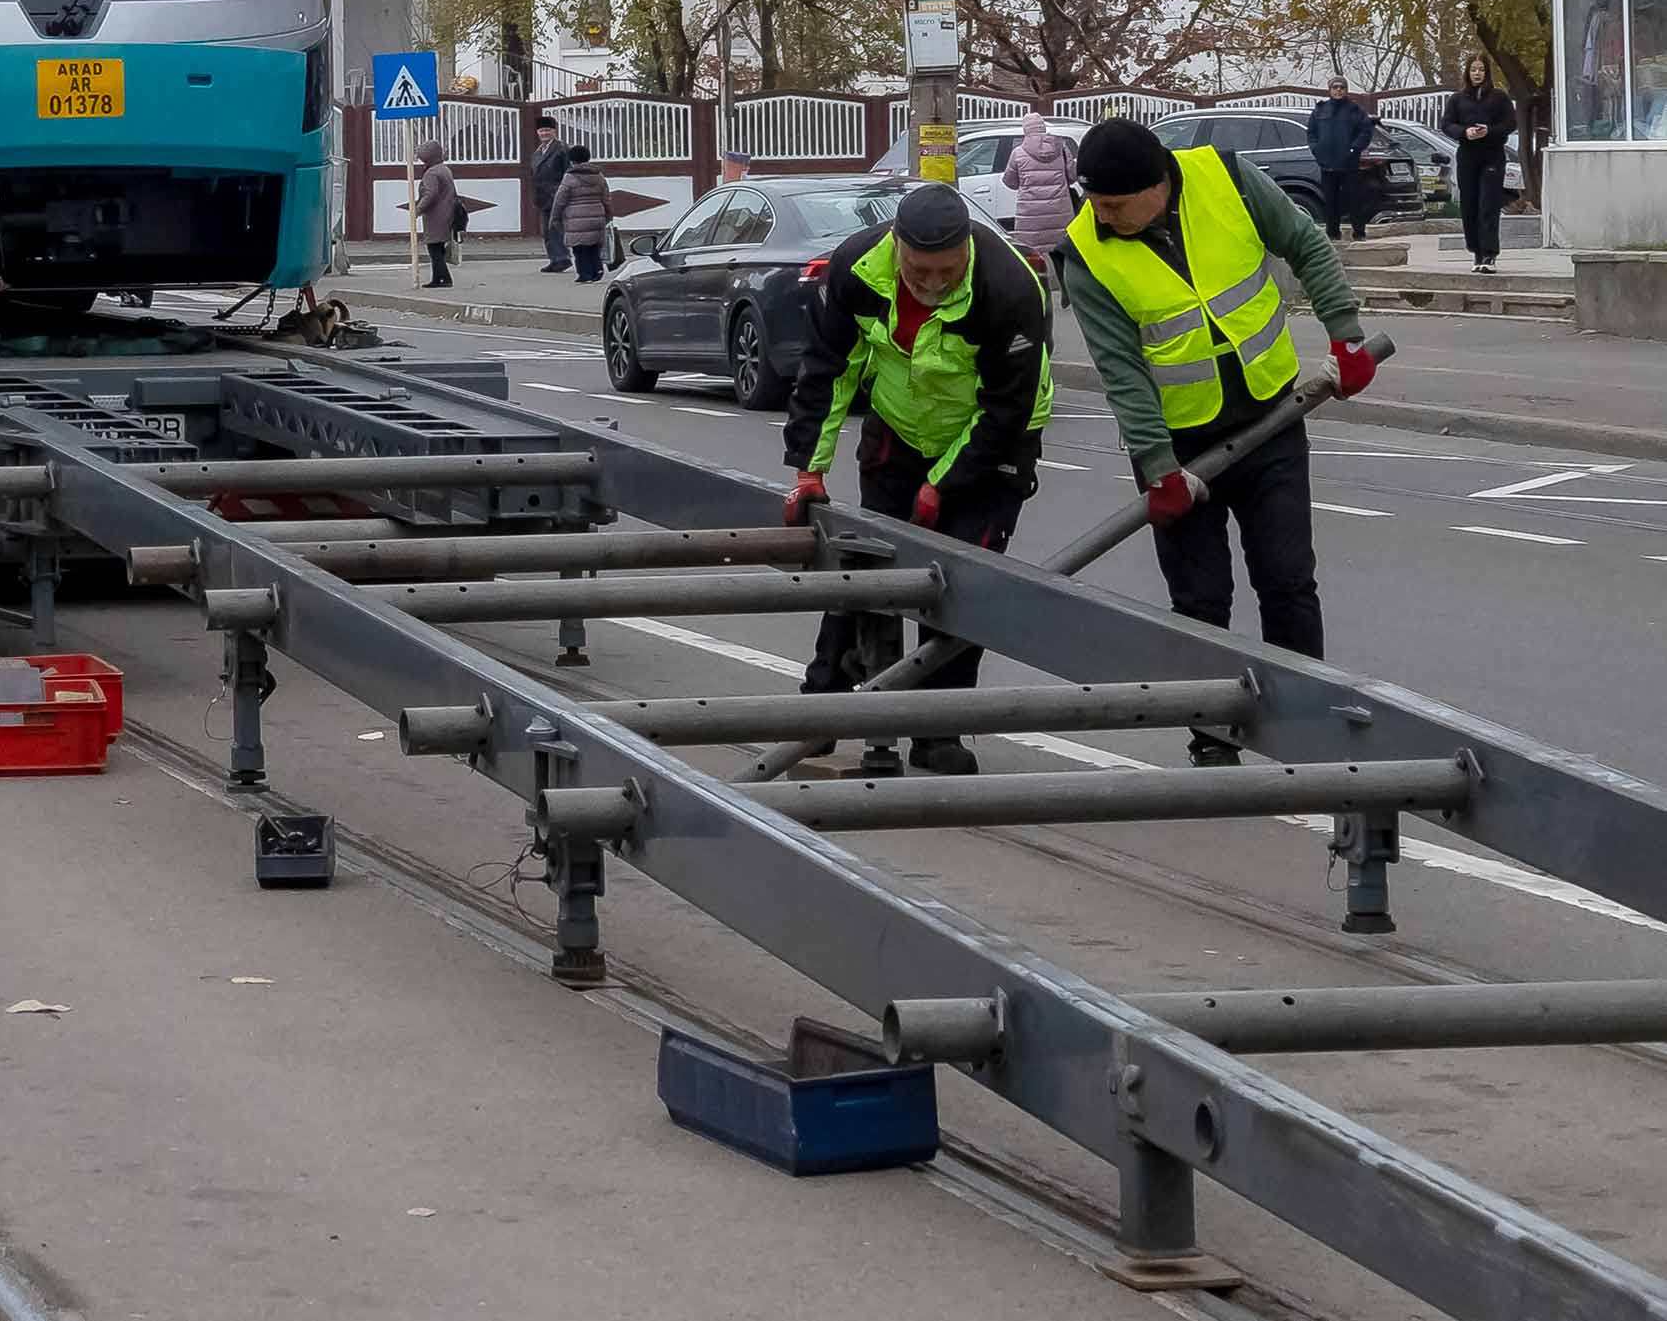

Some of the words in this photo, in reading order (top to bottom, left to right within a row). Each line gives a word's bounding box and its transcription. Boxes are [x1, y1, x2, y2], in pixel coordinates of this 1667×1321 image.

[57, 63, 103, 76] ARAD
[69, 77, 92, 92] AR
[49, 94, 113, 115] 01378
